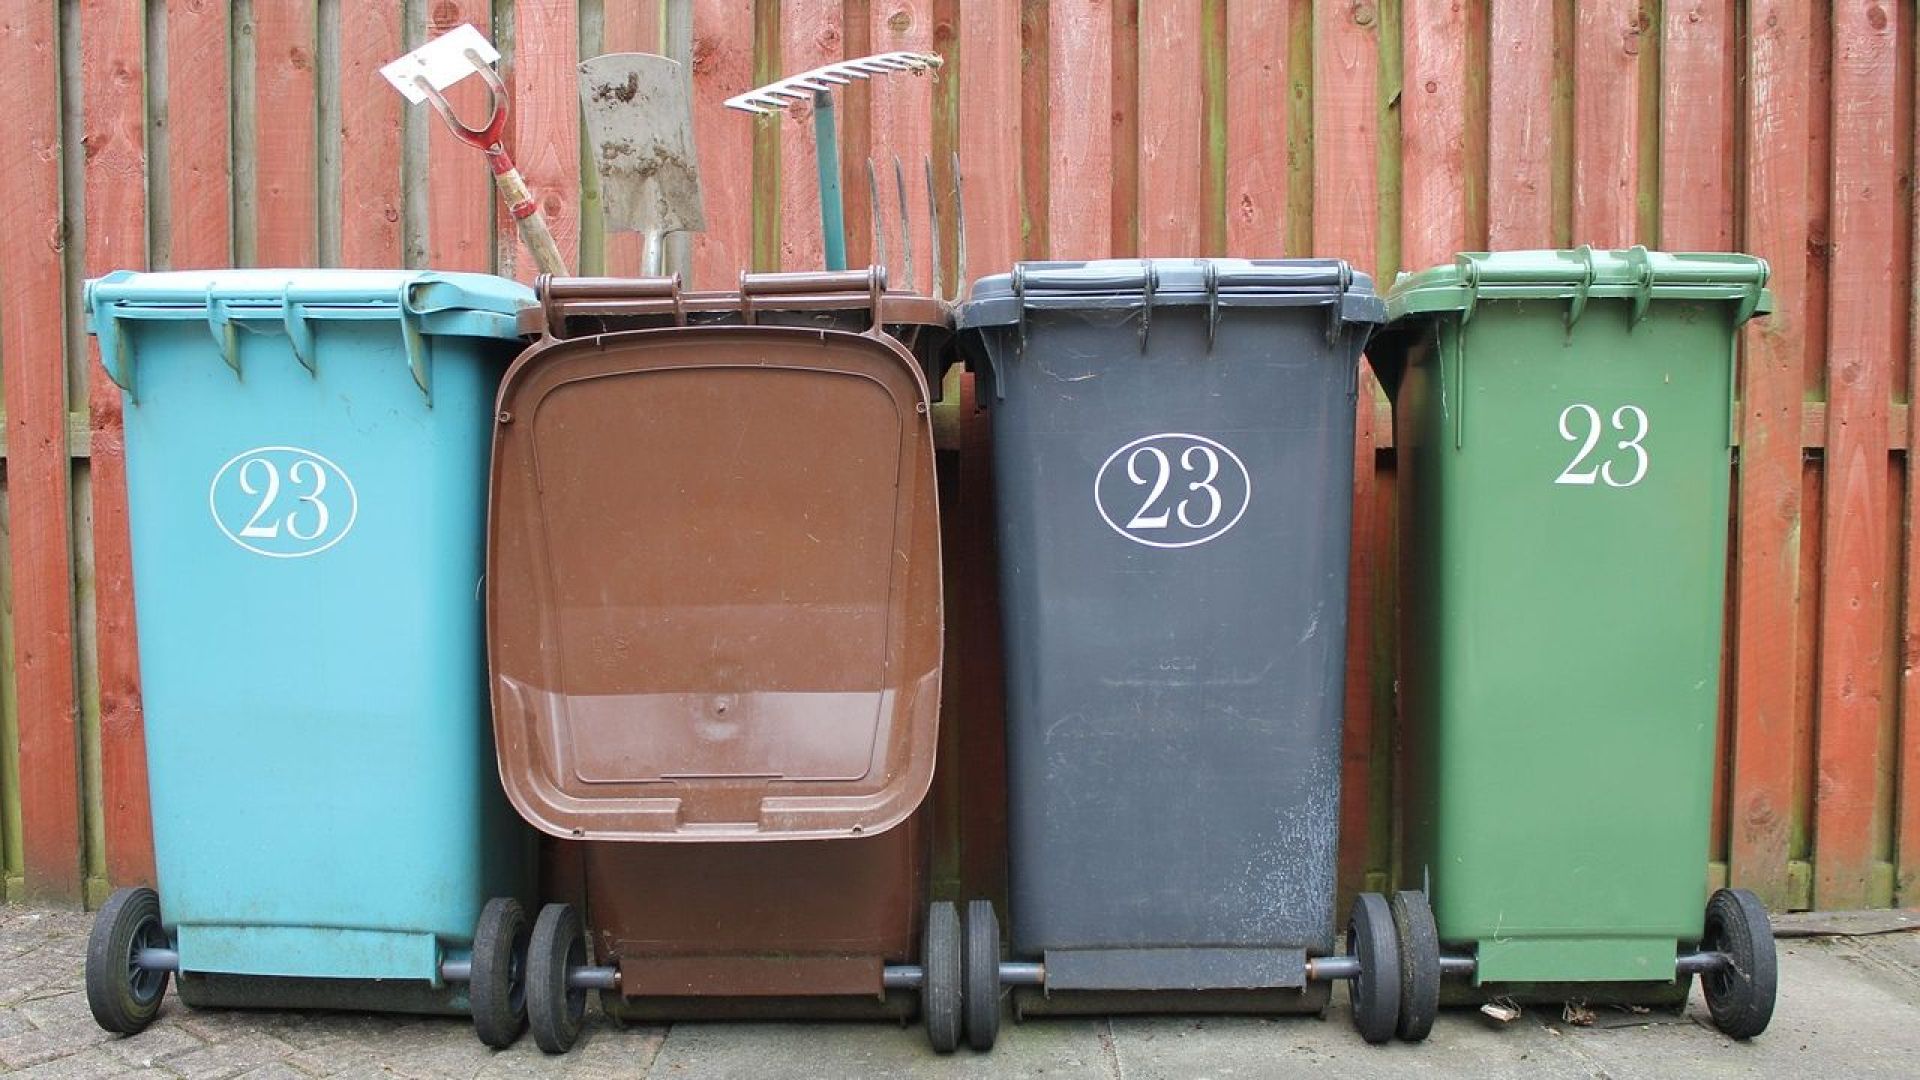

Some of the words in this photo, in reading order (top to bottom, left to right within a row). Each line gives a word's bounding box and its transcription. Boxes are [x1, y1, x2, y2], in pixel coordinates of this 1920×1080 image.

[1554, 404, 1648, 486] 23
[239, 458, 329, 540] 23
[1126, 446, 1222, 529] 23
